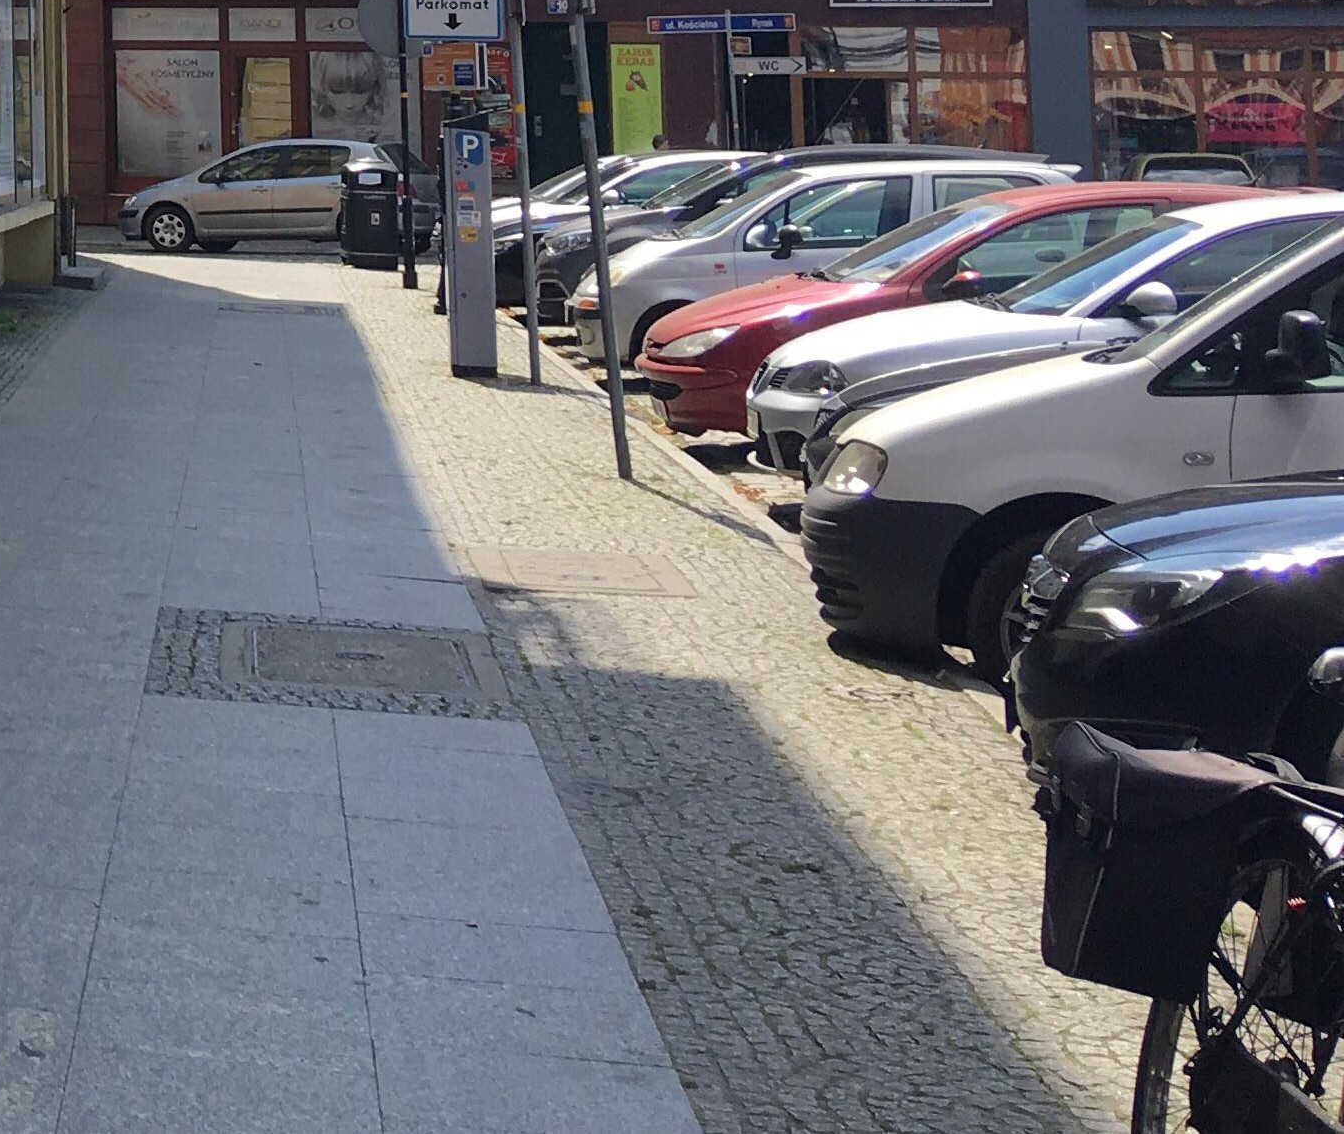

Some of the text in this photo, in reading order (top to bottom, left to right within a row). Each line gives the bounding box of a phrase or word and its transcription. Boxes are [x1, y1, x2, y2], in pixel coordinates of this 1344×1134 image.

[166, 58, 199, 67] SALON
[758, 60, 780, 71] WC
[150, 69, 216, 79] KOSMETYCZNY
[462, 135, 479, 159] P
